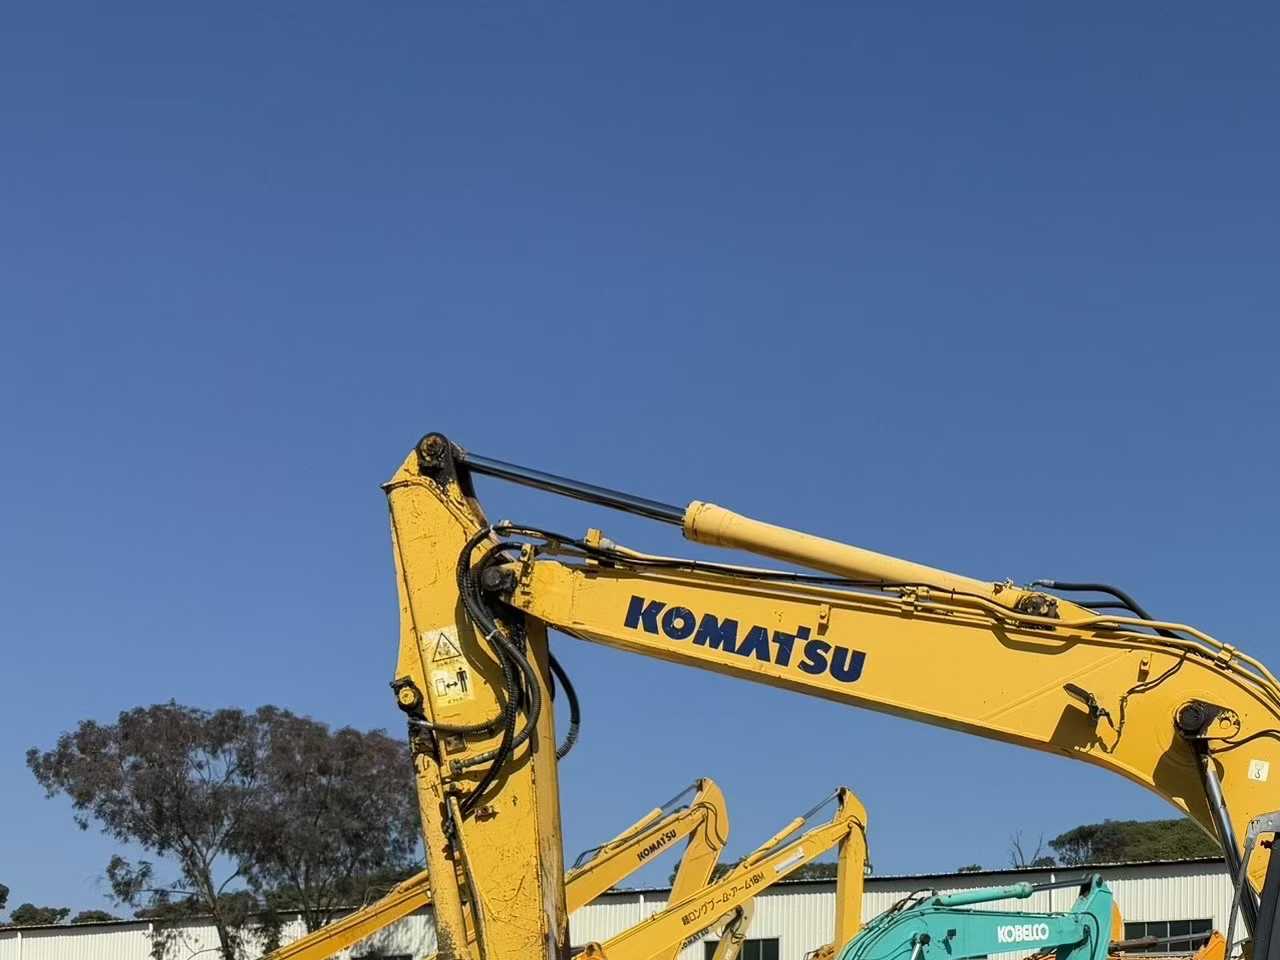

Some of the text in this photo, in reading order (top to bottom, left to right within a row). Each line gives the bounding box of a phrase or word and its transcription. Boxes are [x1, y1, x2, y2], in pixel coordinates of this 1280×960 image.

[624, 595, 866, 683] KOMATSU
[637, 829, 677, 862] KOMATSU
[997, 923, 1049, 943] KOBELCO
